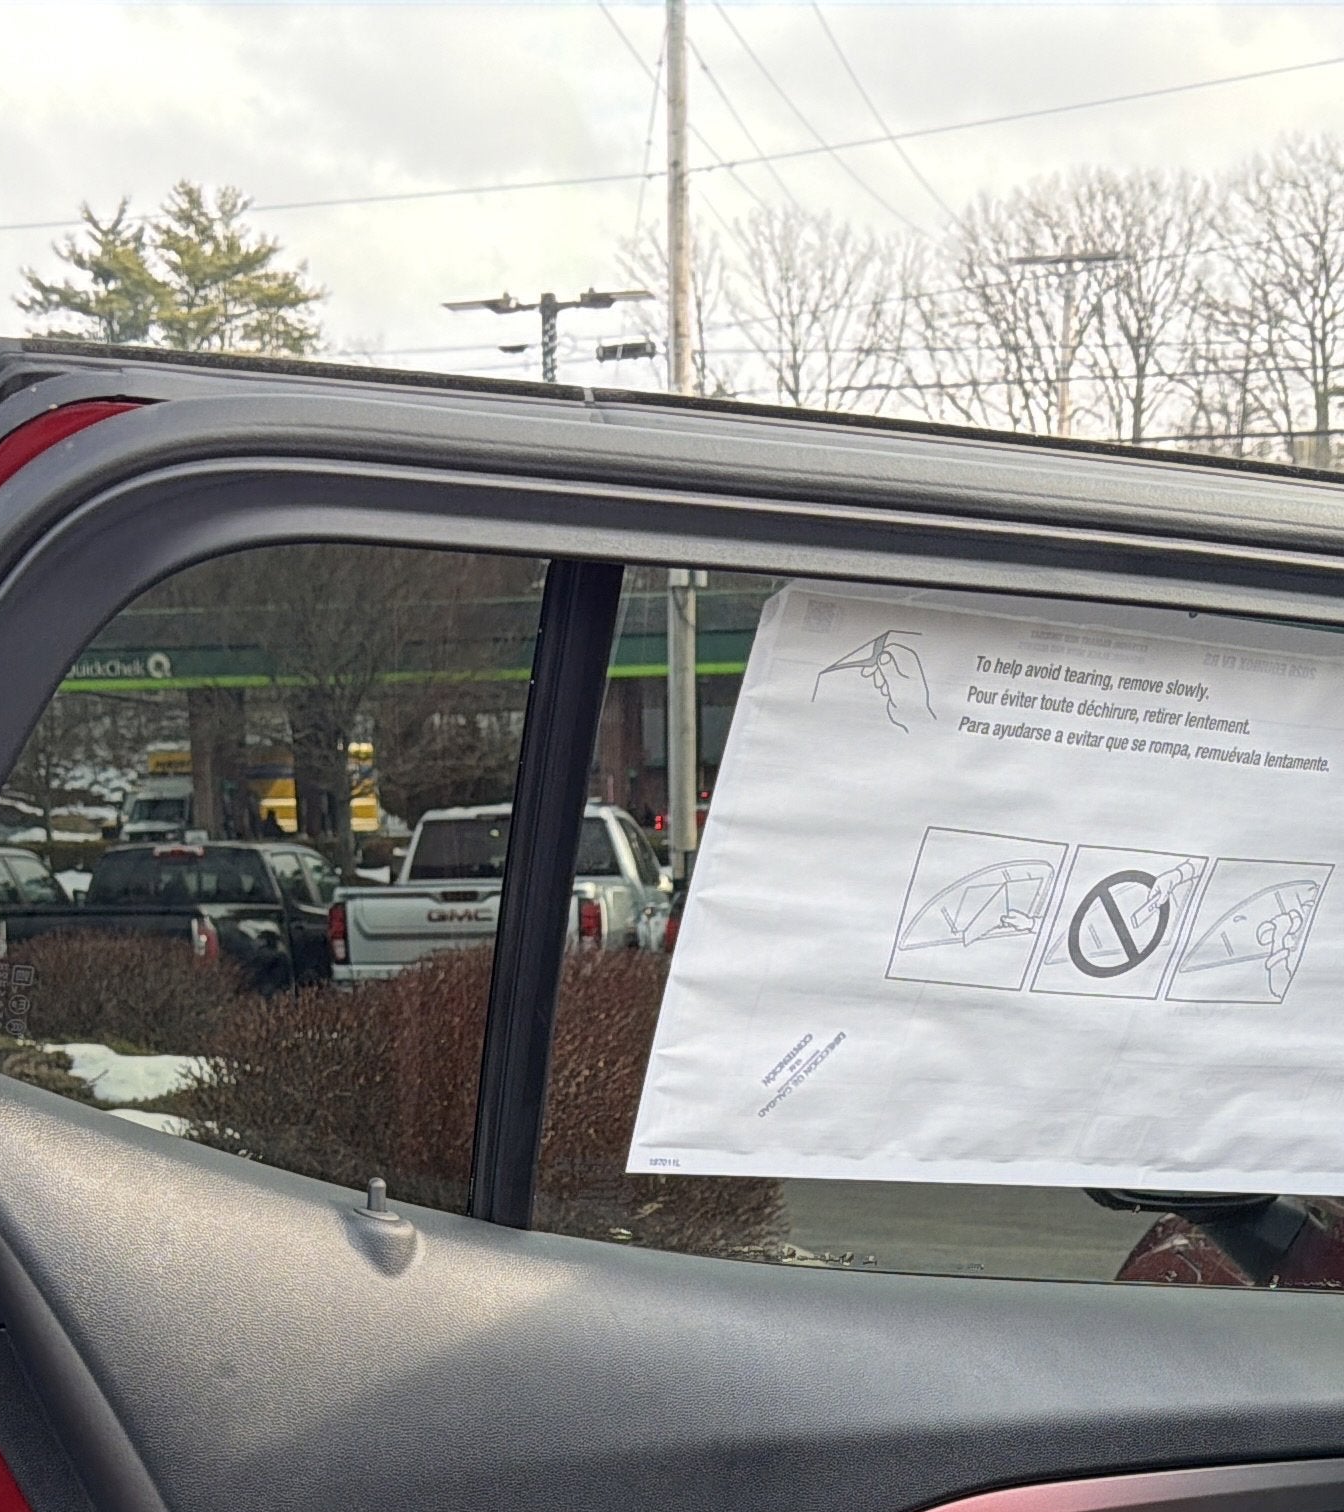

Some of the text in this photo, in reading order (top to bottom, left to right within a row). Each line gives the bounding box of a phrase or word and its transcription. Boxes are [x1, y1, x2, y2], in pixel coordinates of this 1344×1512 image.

[977, 655, 1210, 702] To help avoid tearing, remove slowly.
[967, 685, 1251, 735] Pour éviter toute déchirure, retirer lentement.
[958, 716, 1330, 773] Para ayudarse a evitar que se rompa, remuévala lentamente.
[427, 908, 493, 922] GMC
